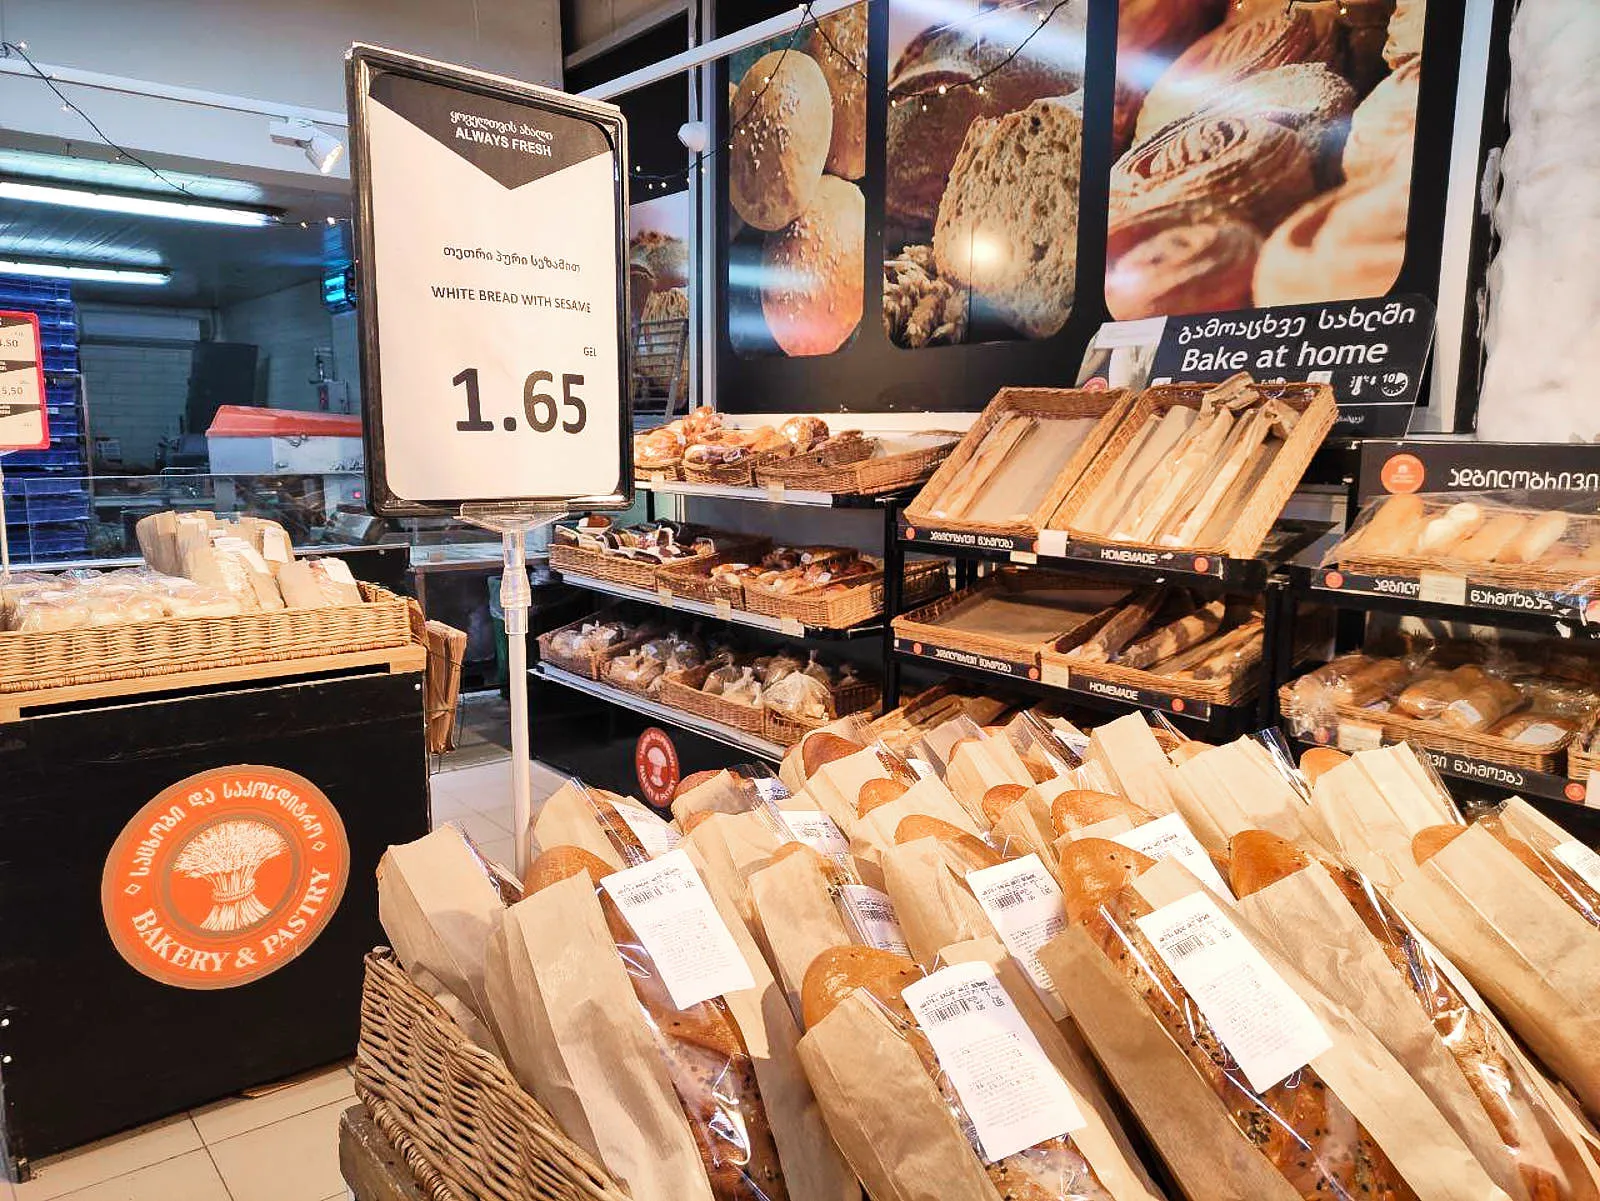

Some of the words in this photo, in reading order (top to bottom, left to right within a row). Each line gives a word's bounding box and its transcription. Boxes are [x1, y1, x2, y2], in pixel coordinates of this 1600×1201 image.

[455, 127, 509, 148] ALWAYS
[512, 138, 552, 157] FRESH
[443, 246, 493, 261] თეთრი
[496, 250, 528, 266] პური
[431, 286, 476, 301] WHITE
[479, 289, 519, 305] BREAD
[521, 293, 552, 308] WITH
[1178, 315, 1306, 345] გამოაცხვე
[1317, 302, 1416, 333] სახლში
[583, 346, 597, 357] GEL
[1181, 347, 1249, 372] Bake
[1256, 346, 1286, 369] at
[1297, 340, 1389, 367] home
[451, 367, 588, 435] 1.65
[1447, 468, 1599, 491] ადგილობრივი
[1100, 548, 1157, 565] HOMEMADE
[1089, 681, 1138, 701] HOMEMADE
[1454, 759, 1524, 787] წარმოება
[128, 805, 187, 877] საცხობი
[188, 788, 217, 808] და
[222, 780, 324, 839] საკონდიტრო
[131, 907, 230, 972] BAKERY
[234, 946, 257, 969] &
[261, 863, 331, 957] PASTRY
